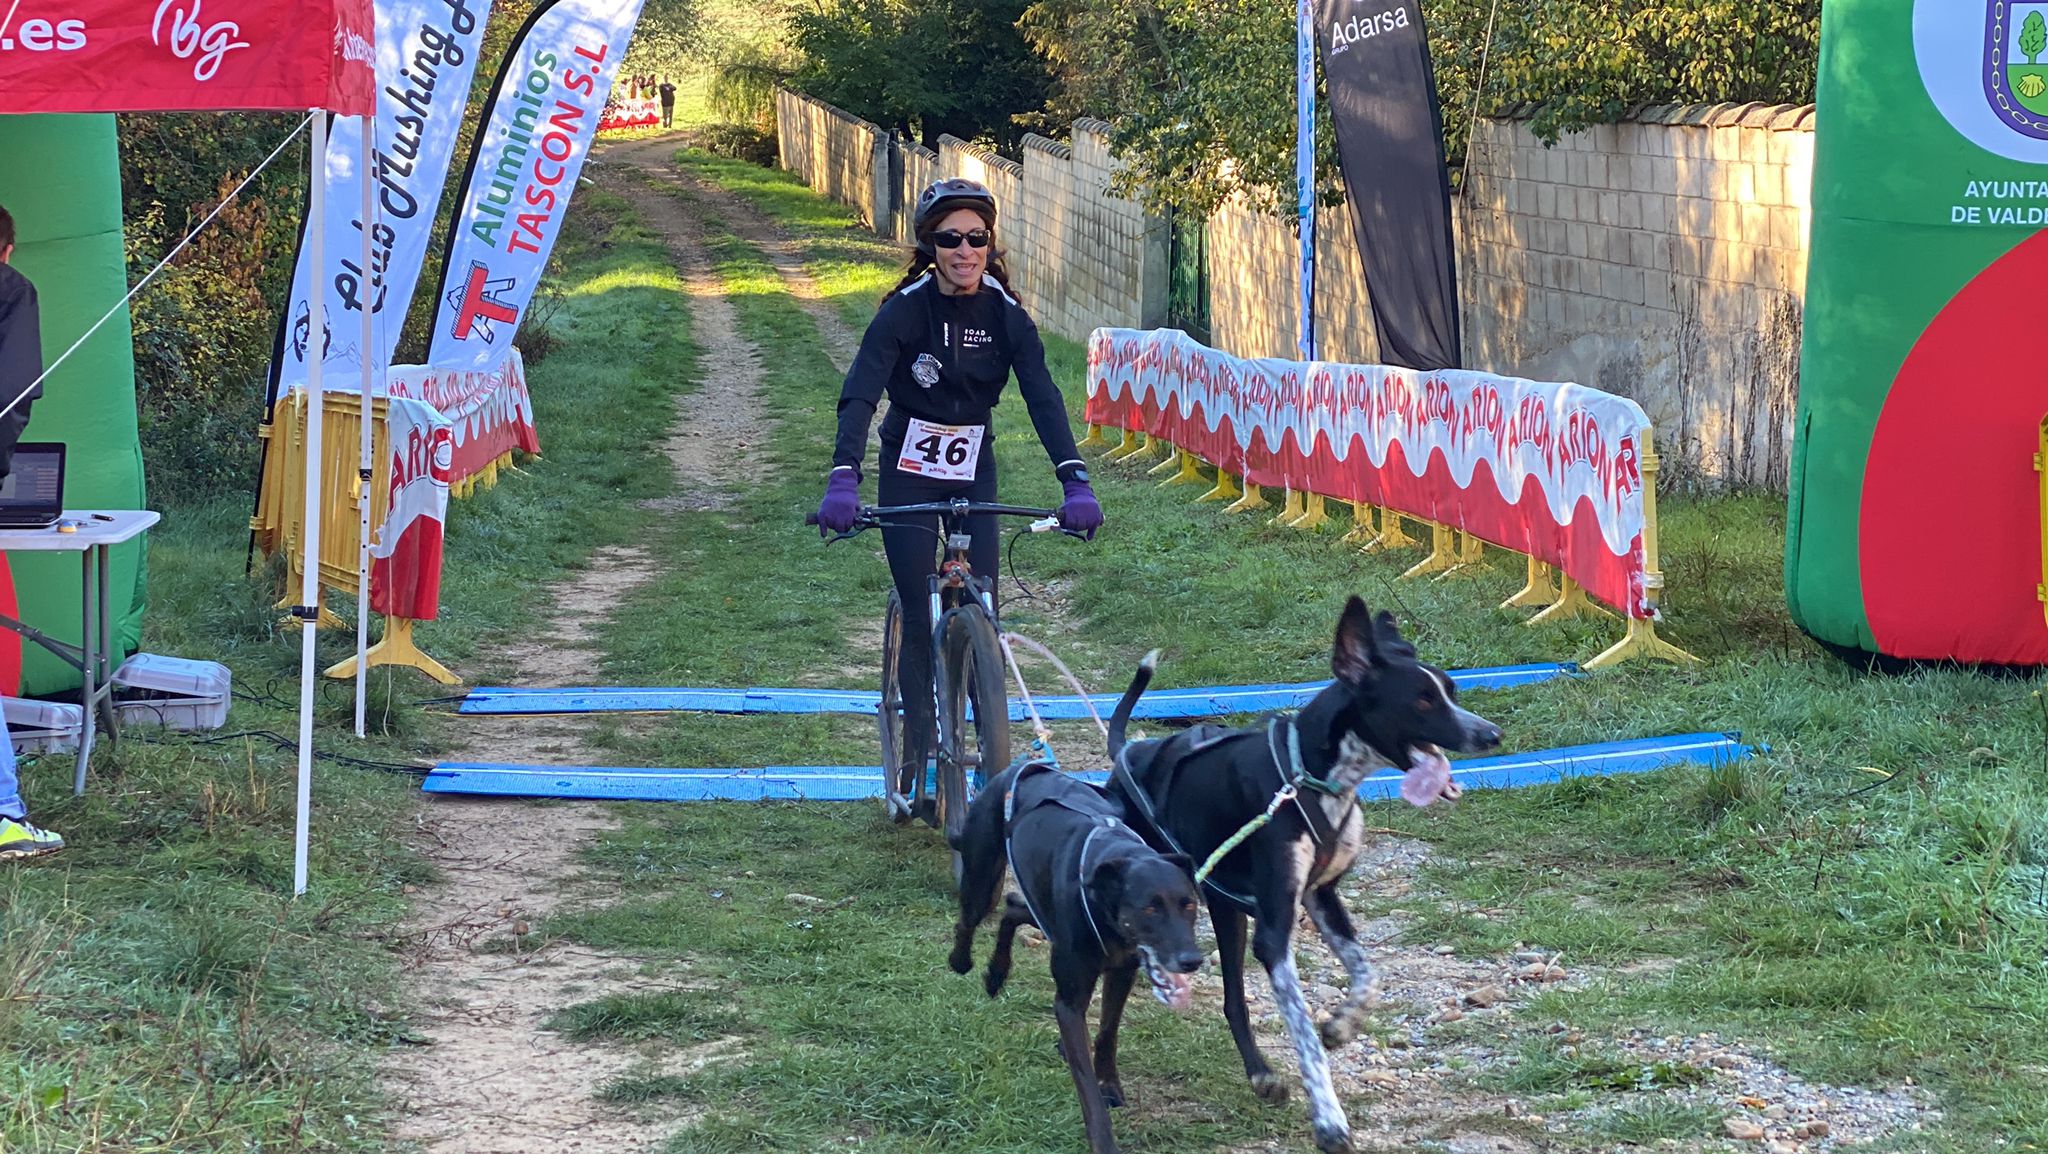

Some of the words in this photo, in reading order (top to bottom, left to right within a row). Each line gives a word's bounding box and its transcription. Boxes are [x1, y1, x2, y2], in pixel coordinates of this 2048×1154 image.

[2, 19, 87, 51] .es
[1331, 6, 1409, 48] Adarsa
[1331, 44, 1349, 56] GRUPO
[371, 23, 464, 219] Mushing
[471, 49, 557, 249] Aluminios
[507, 100, 585, 254] TASCON
[1951, 205, 1981, 224] DE
[1987, 207, 2048, 225] VALD
[963, 335, 993, 343] RACING
[964, 328, 986, 337] ROAD
[915, 434, 969, 466] 46
[1274, 371, 1301, 426] ARION
[1307, 371, 1336, 432] ARION
[1341, 371, 1372, 434] ARION
[1377, 372, 1412, 439] ARION
[1417, 377, 1460, 448] ARION
[1463, 383, 1505, 462] ARION
[1508, 392, 1554, 479] ARION
[1559, 408, 1612, 504] ARION
